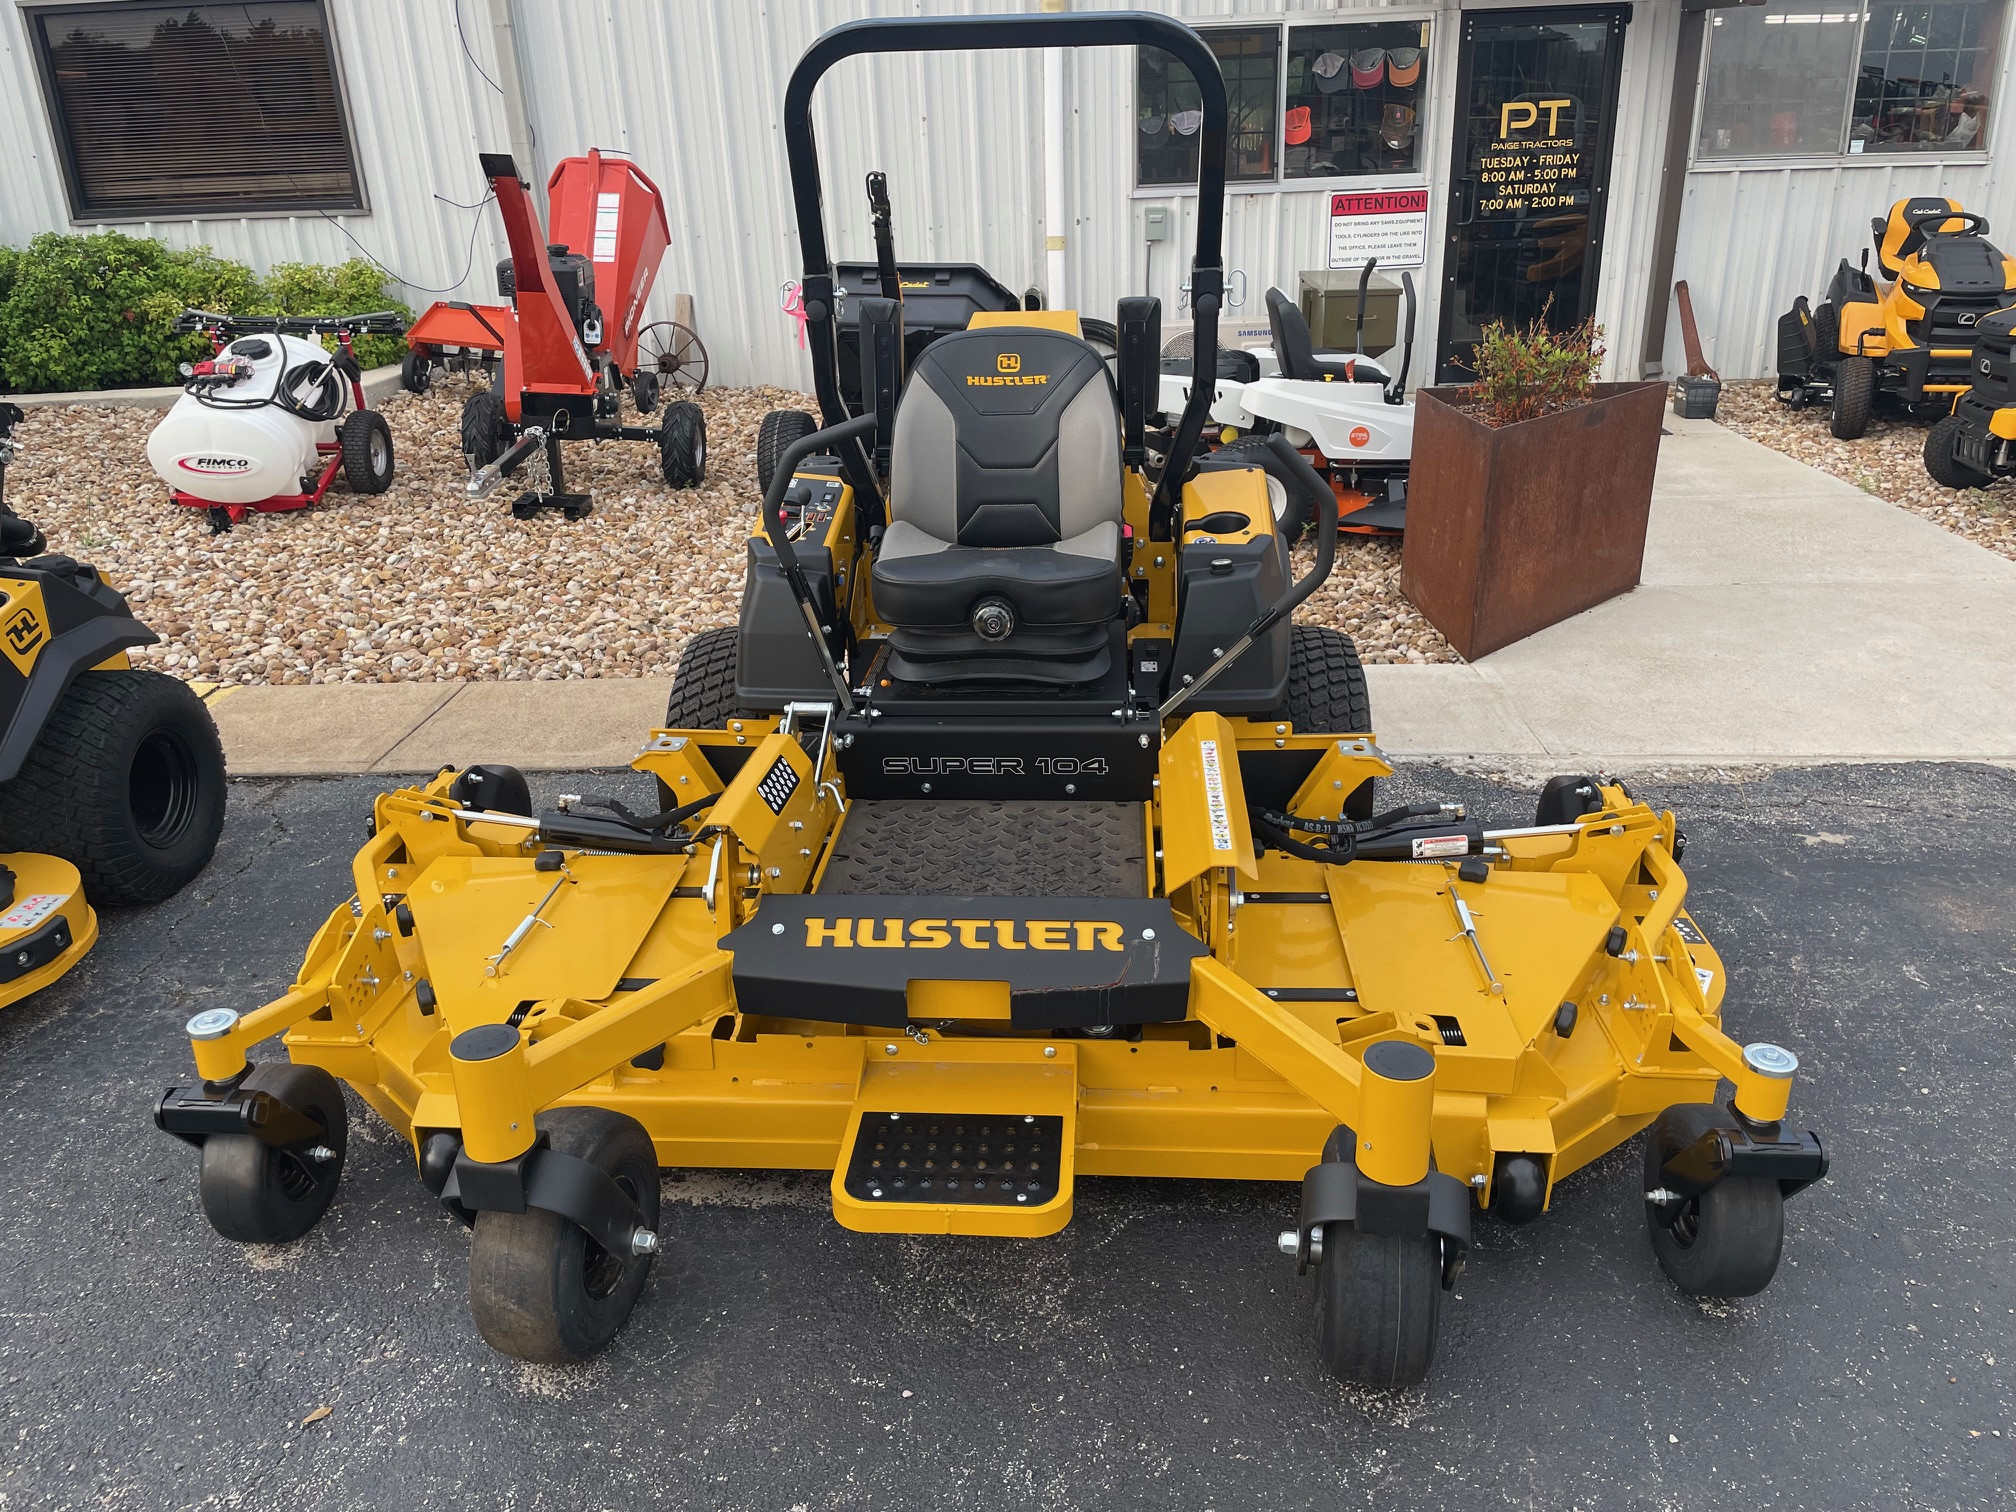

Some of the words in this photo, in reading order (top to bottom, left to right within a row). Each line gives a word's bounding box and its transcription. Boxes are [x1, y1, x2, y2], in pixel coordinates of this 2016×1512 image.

[1500, 99, 1571, 139] PT
[1491, 141, 1519, 151] PAIGE
[1521, 139, 1573, 150] TRACTORS
[1480, 156, 1530, 169] TUESDAY
[1539, 153, 1580, 166] FRIDAY
[1481, 171, 1506, 183] 8:00
[1508, 170, 1525, 181] AM
[1534, 168, 1558, 180] 5:00
[1561, 167, 1577, 179] PM
[1498, 182, 1557, 196] SATURDAY
[1334, 194, 1425, 211] ATTENTION!
[1479, 199, 1503, 211] 7:00
[1505, 198, 1522, 209] AM
[1531, 196, 1556, 208] 2:00
[1558, 195, 1575, 206] PM
[624, 266, 649, 336] PIONEER
[966, 374, 1047, 386] HUSTLER
[197, 458, 248, 467] FIMCO
[882, 757, 1025, 775] SUPER
[1034, 757, 1109, 775] 104
[804, 917, 1125, 952] HUSTLER
